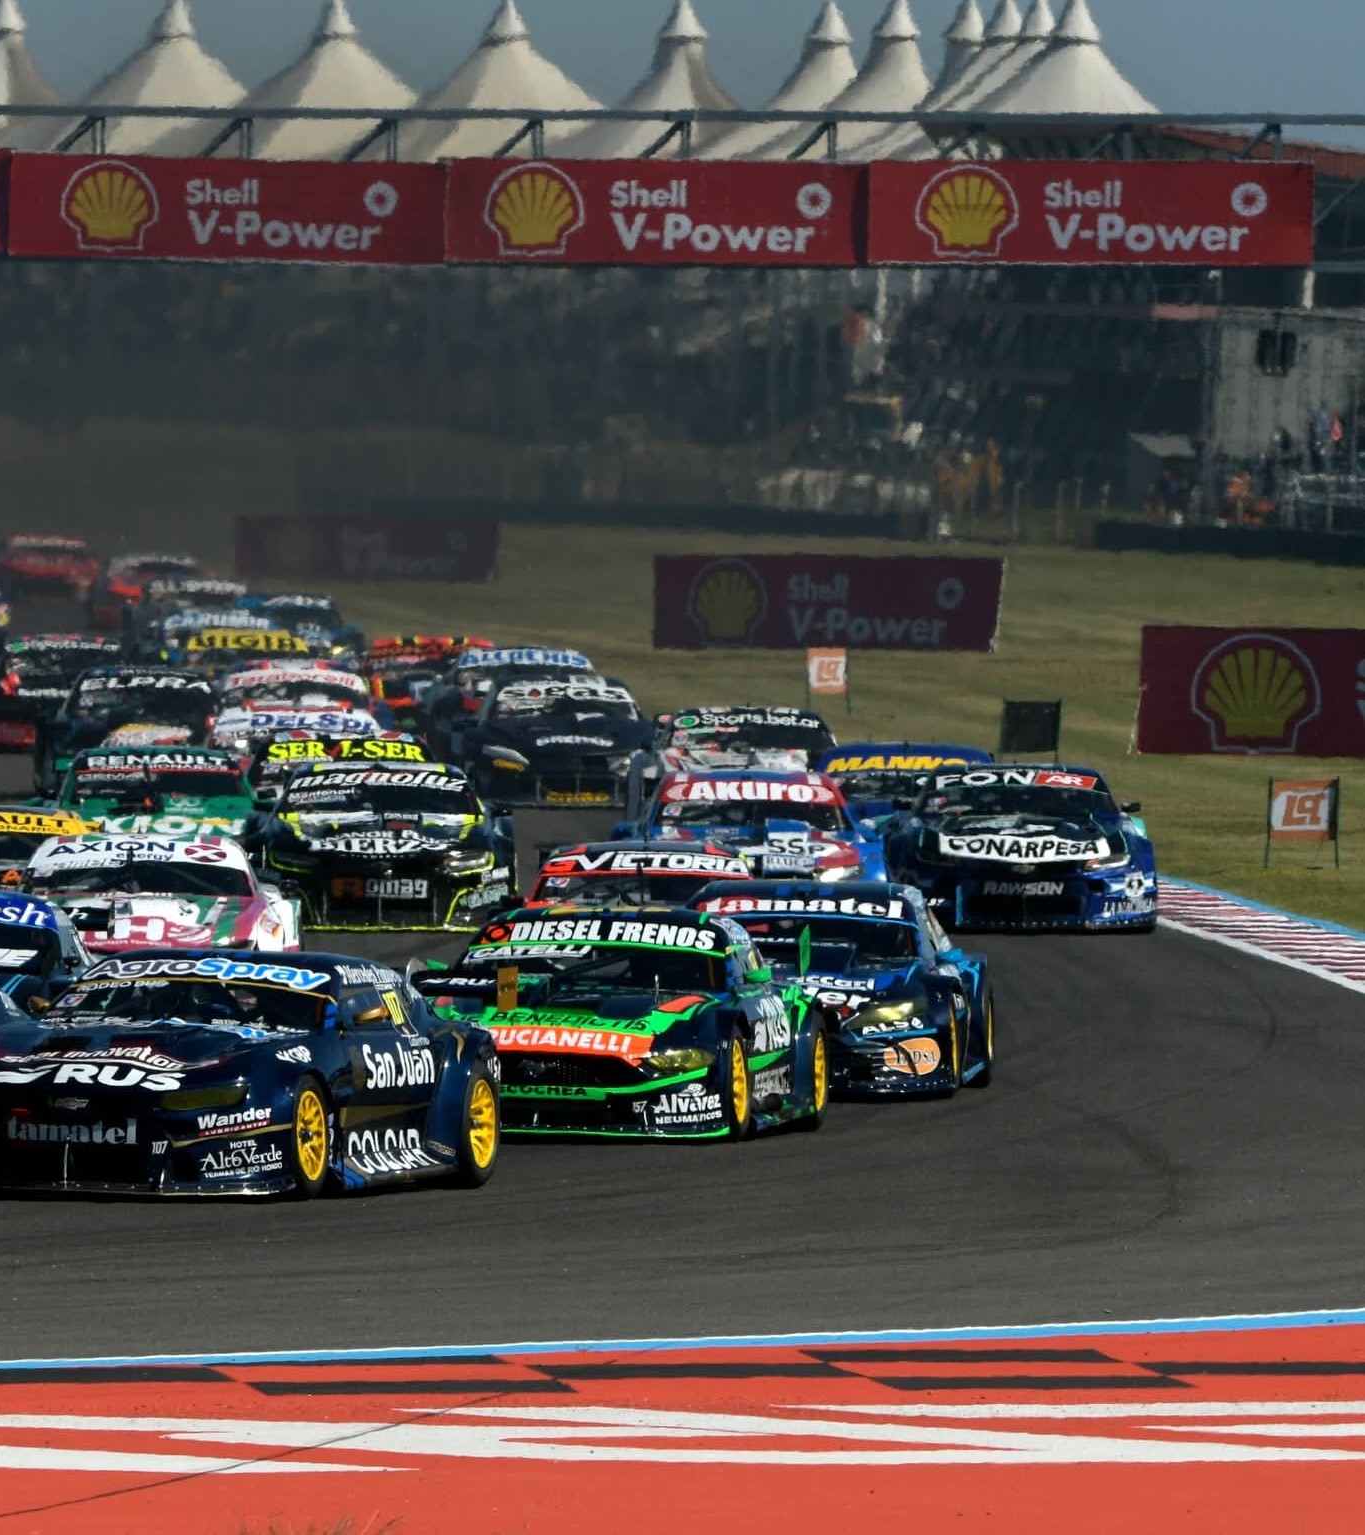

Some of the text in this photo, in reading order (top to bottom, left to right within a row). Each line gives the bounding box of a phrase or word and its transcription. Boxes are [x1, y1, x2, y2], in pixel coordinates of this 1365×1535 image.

[185, 178, 260, 206] Shell
[610, 180, 687, 208] Shell
[1044, 181, 1122, 209] Shell
[185, 210, 383, 251] V-Power
[610, 213, 815, 254] V-Power
[1044, 214, 1250, 254] V-Power
[787, 575, 849, 602] Shell
[788, 610, 948, 646] V-Power
[87, 754, 229, 769] RENAULT
[91, 815, 246, 835] XION
[46, 841, 175, 858] AXION
[948, 837, 1100, 859] CONARPESA
[560, 851, 750, 876] VICTORIA
[983, 881, 1065, 896] RAWSON
[706, 898, 904, 919] tamatel
[510, 919, 716, 951] DIESEL FRENOS
[82, 957, 332, 990] AgroSpray
[492, 1029, 632, 1053] RUCIANELLI
[53, 1063, 186, 1092] RUS
[7, 1115, 139, 1146] tamatel
[197, 1107, 272, 1131] Wander
[151, 1140, 169, 1155] 107
[230, 1138, 258, 1150] HOTEL
